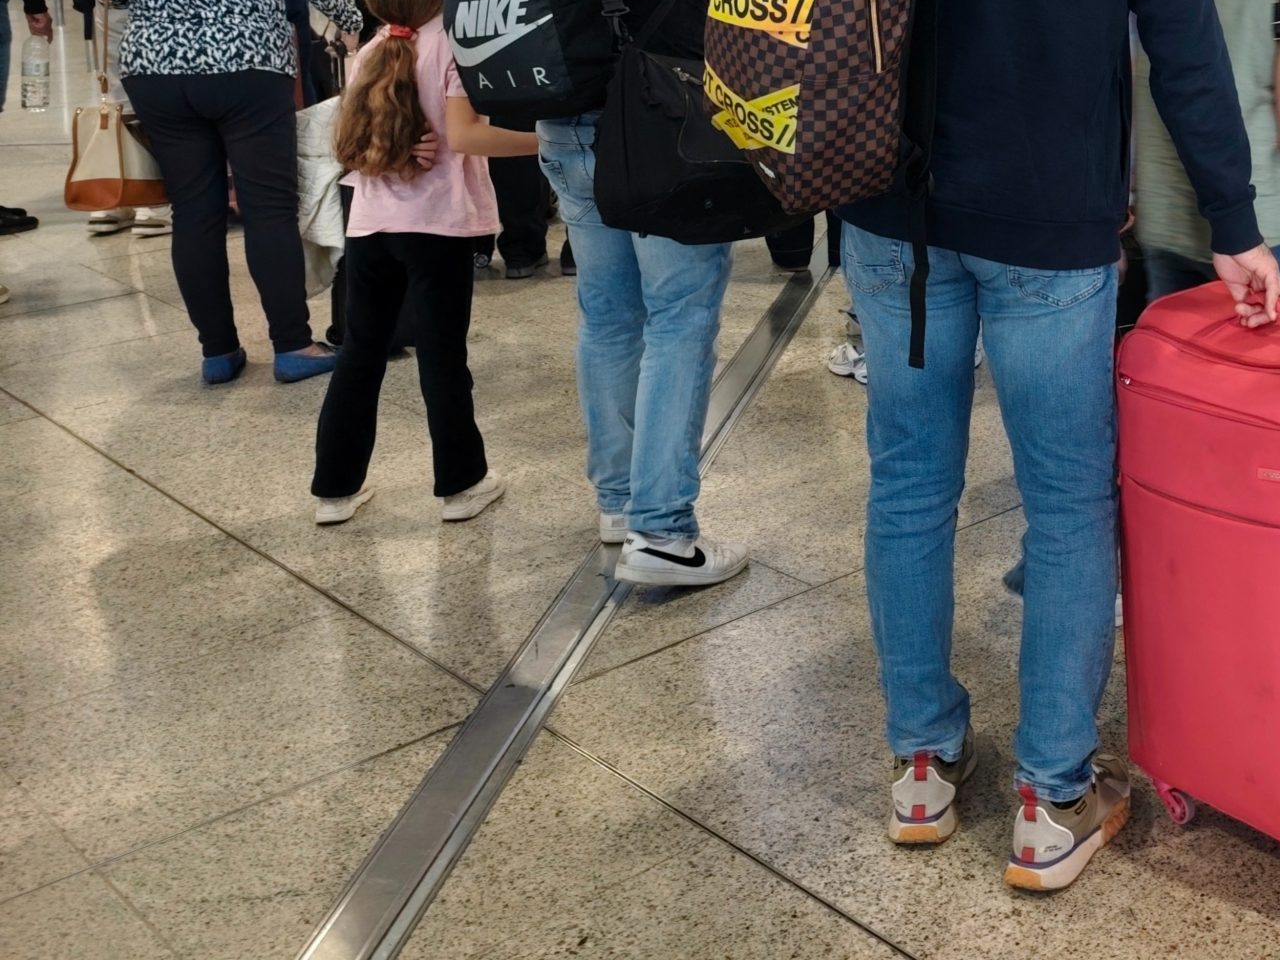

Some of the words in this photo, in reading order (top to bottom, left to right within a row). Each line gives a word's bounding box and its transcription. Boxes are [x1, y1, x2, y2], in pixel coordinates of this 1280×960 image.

[478, 66, 552, 90] AIR
[715, 84, 775, 142] CROSS
[762, 95, 799, 116] STEM
